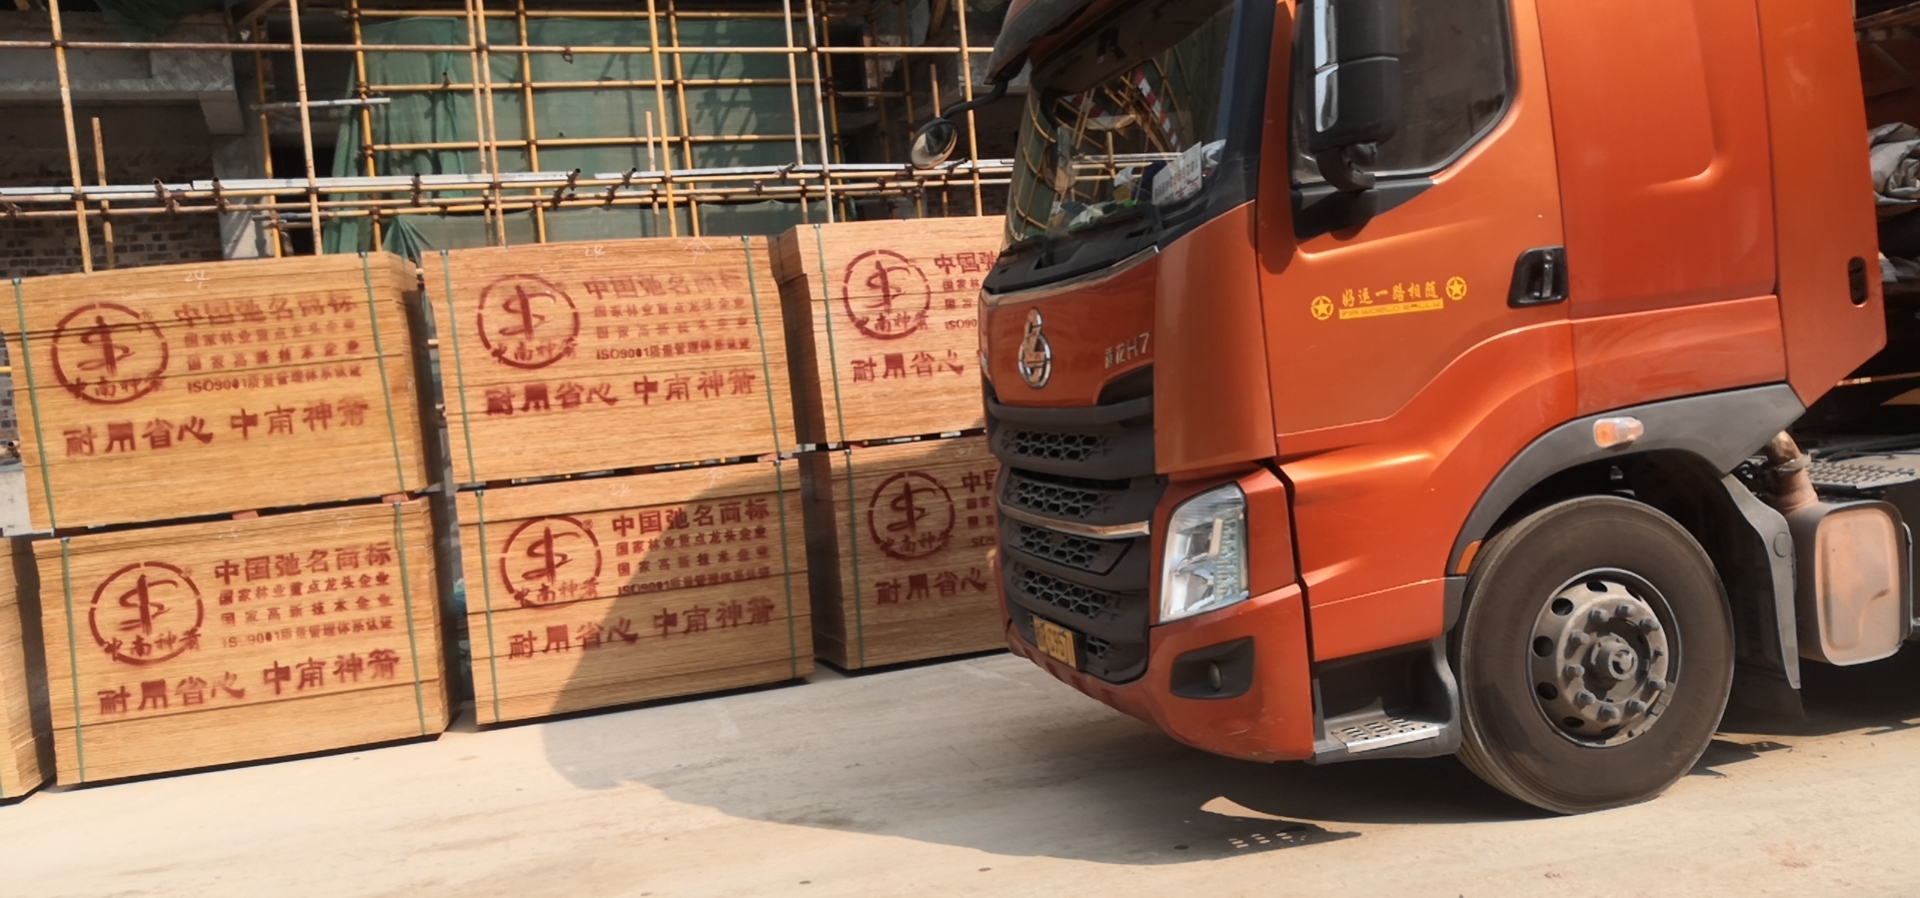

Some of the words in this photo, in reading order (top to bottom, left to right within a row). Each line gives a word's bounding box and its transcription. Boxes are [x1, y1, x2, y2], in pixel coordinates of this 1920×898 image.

[1342, 281, 1439, 308] 好运一路相随
[851, 349, 964, 383] 耐用省心
[485, 381, 619, 416] 耐用省心
[63, 415, 213, 457] 耐用省心
[875, 567, 987, 605] 耐用省心
[223, 615, 393, 649] IS9001质量管理体系认证
[508, 617, 639, 660] 耐用省心
[653, 596, 775, 638] 中南神箭
[98, 671, 245, 715] 耐用省心
[263, 649, 400, 695] 中南神箭
